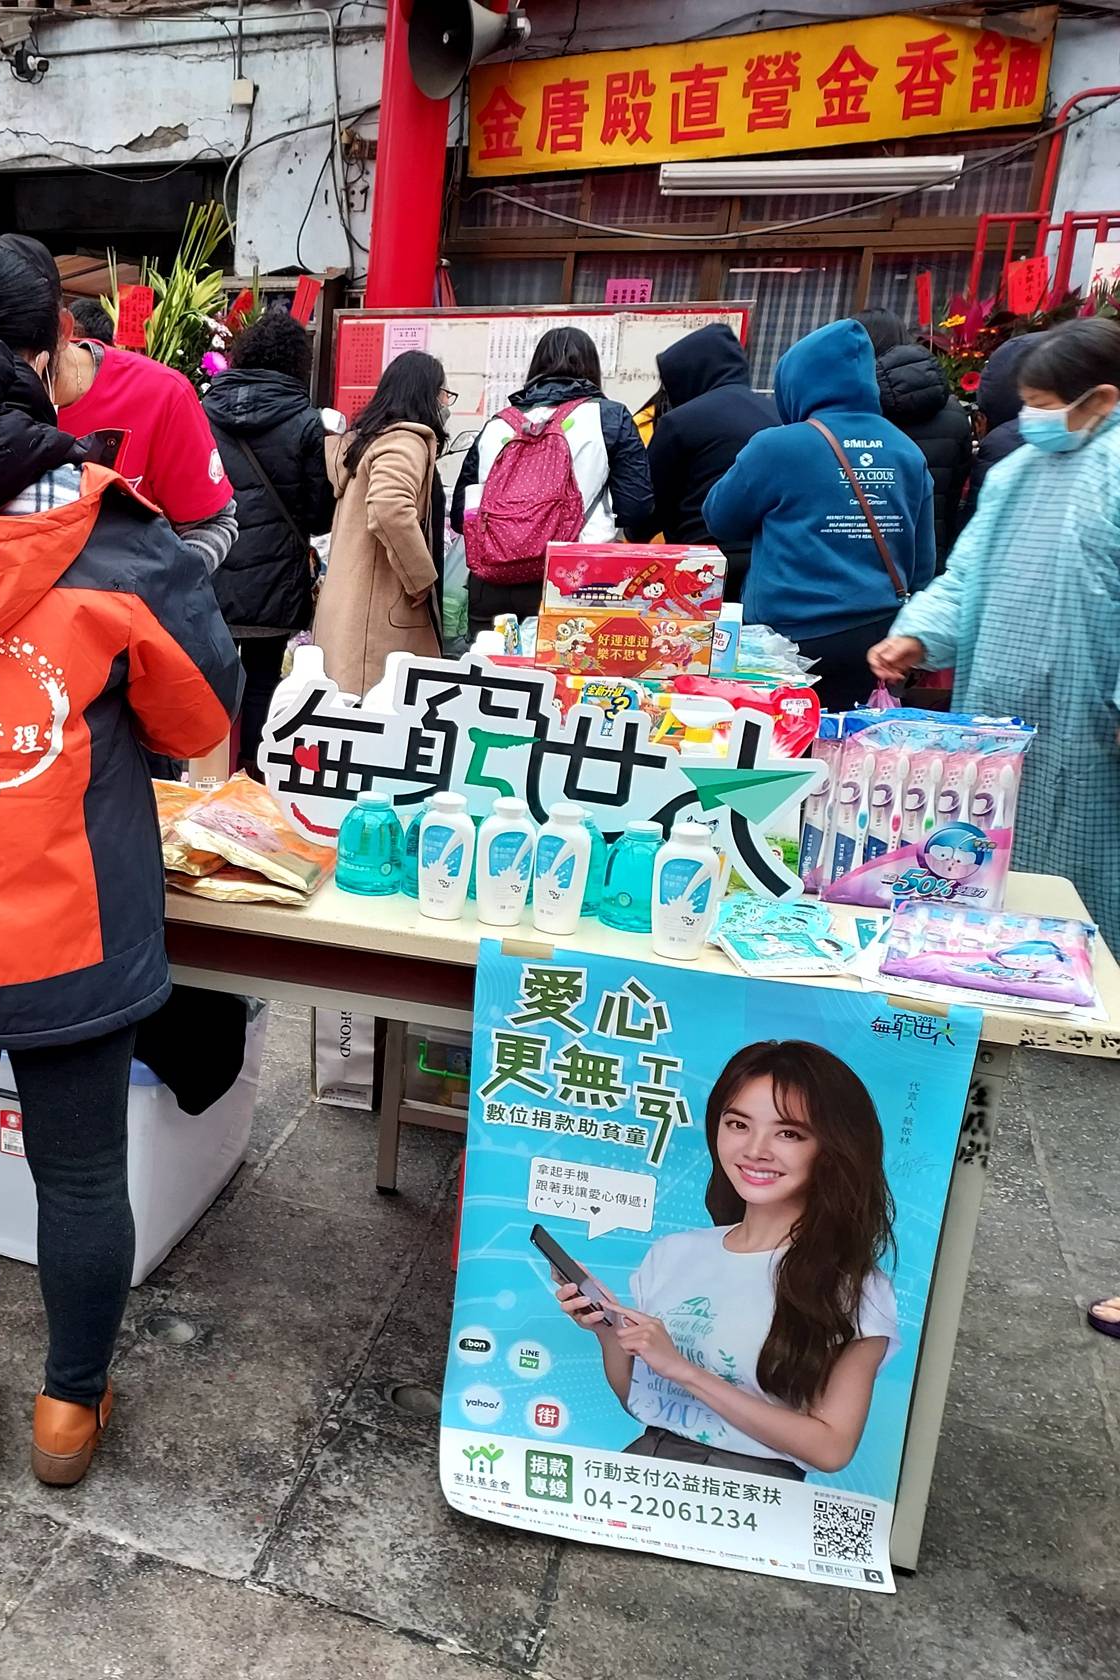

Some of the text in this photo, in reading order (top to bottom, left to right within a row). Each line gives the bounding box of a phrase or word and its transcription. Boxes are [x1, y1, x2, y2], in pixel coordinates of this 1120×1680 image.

[843, 439, 883, 448] SIMILAR
[597, 634, 649, 648] 好運連連
[891, 868, 953, 897] 50%
[510, 968, 667, 1041] 愛心
[905, 1081, 921, 1111] 代言人
[487, 1104, 646, 1145] 數位捐款助貧童
[537, 1164, 589, 1182] 拿起手機
[520, 1349, 540, 1358] LINE
[521, 1358, 538, 1368] Pay
[465, 1399, 500, 1409] yahoo!
[537, 1406, 557, 1425] 街
[530, 1454, 568, 1478] 捐款
[453, 1473, 511, 1490] 家扶基金會
[530, 1477, 568, 1499] 專線
[584, 1460, 782, 1505] 行動支付公益指定家扶
[584, 1488, 758, 1531] 04-22061234
